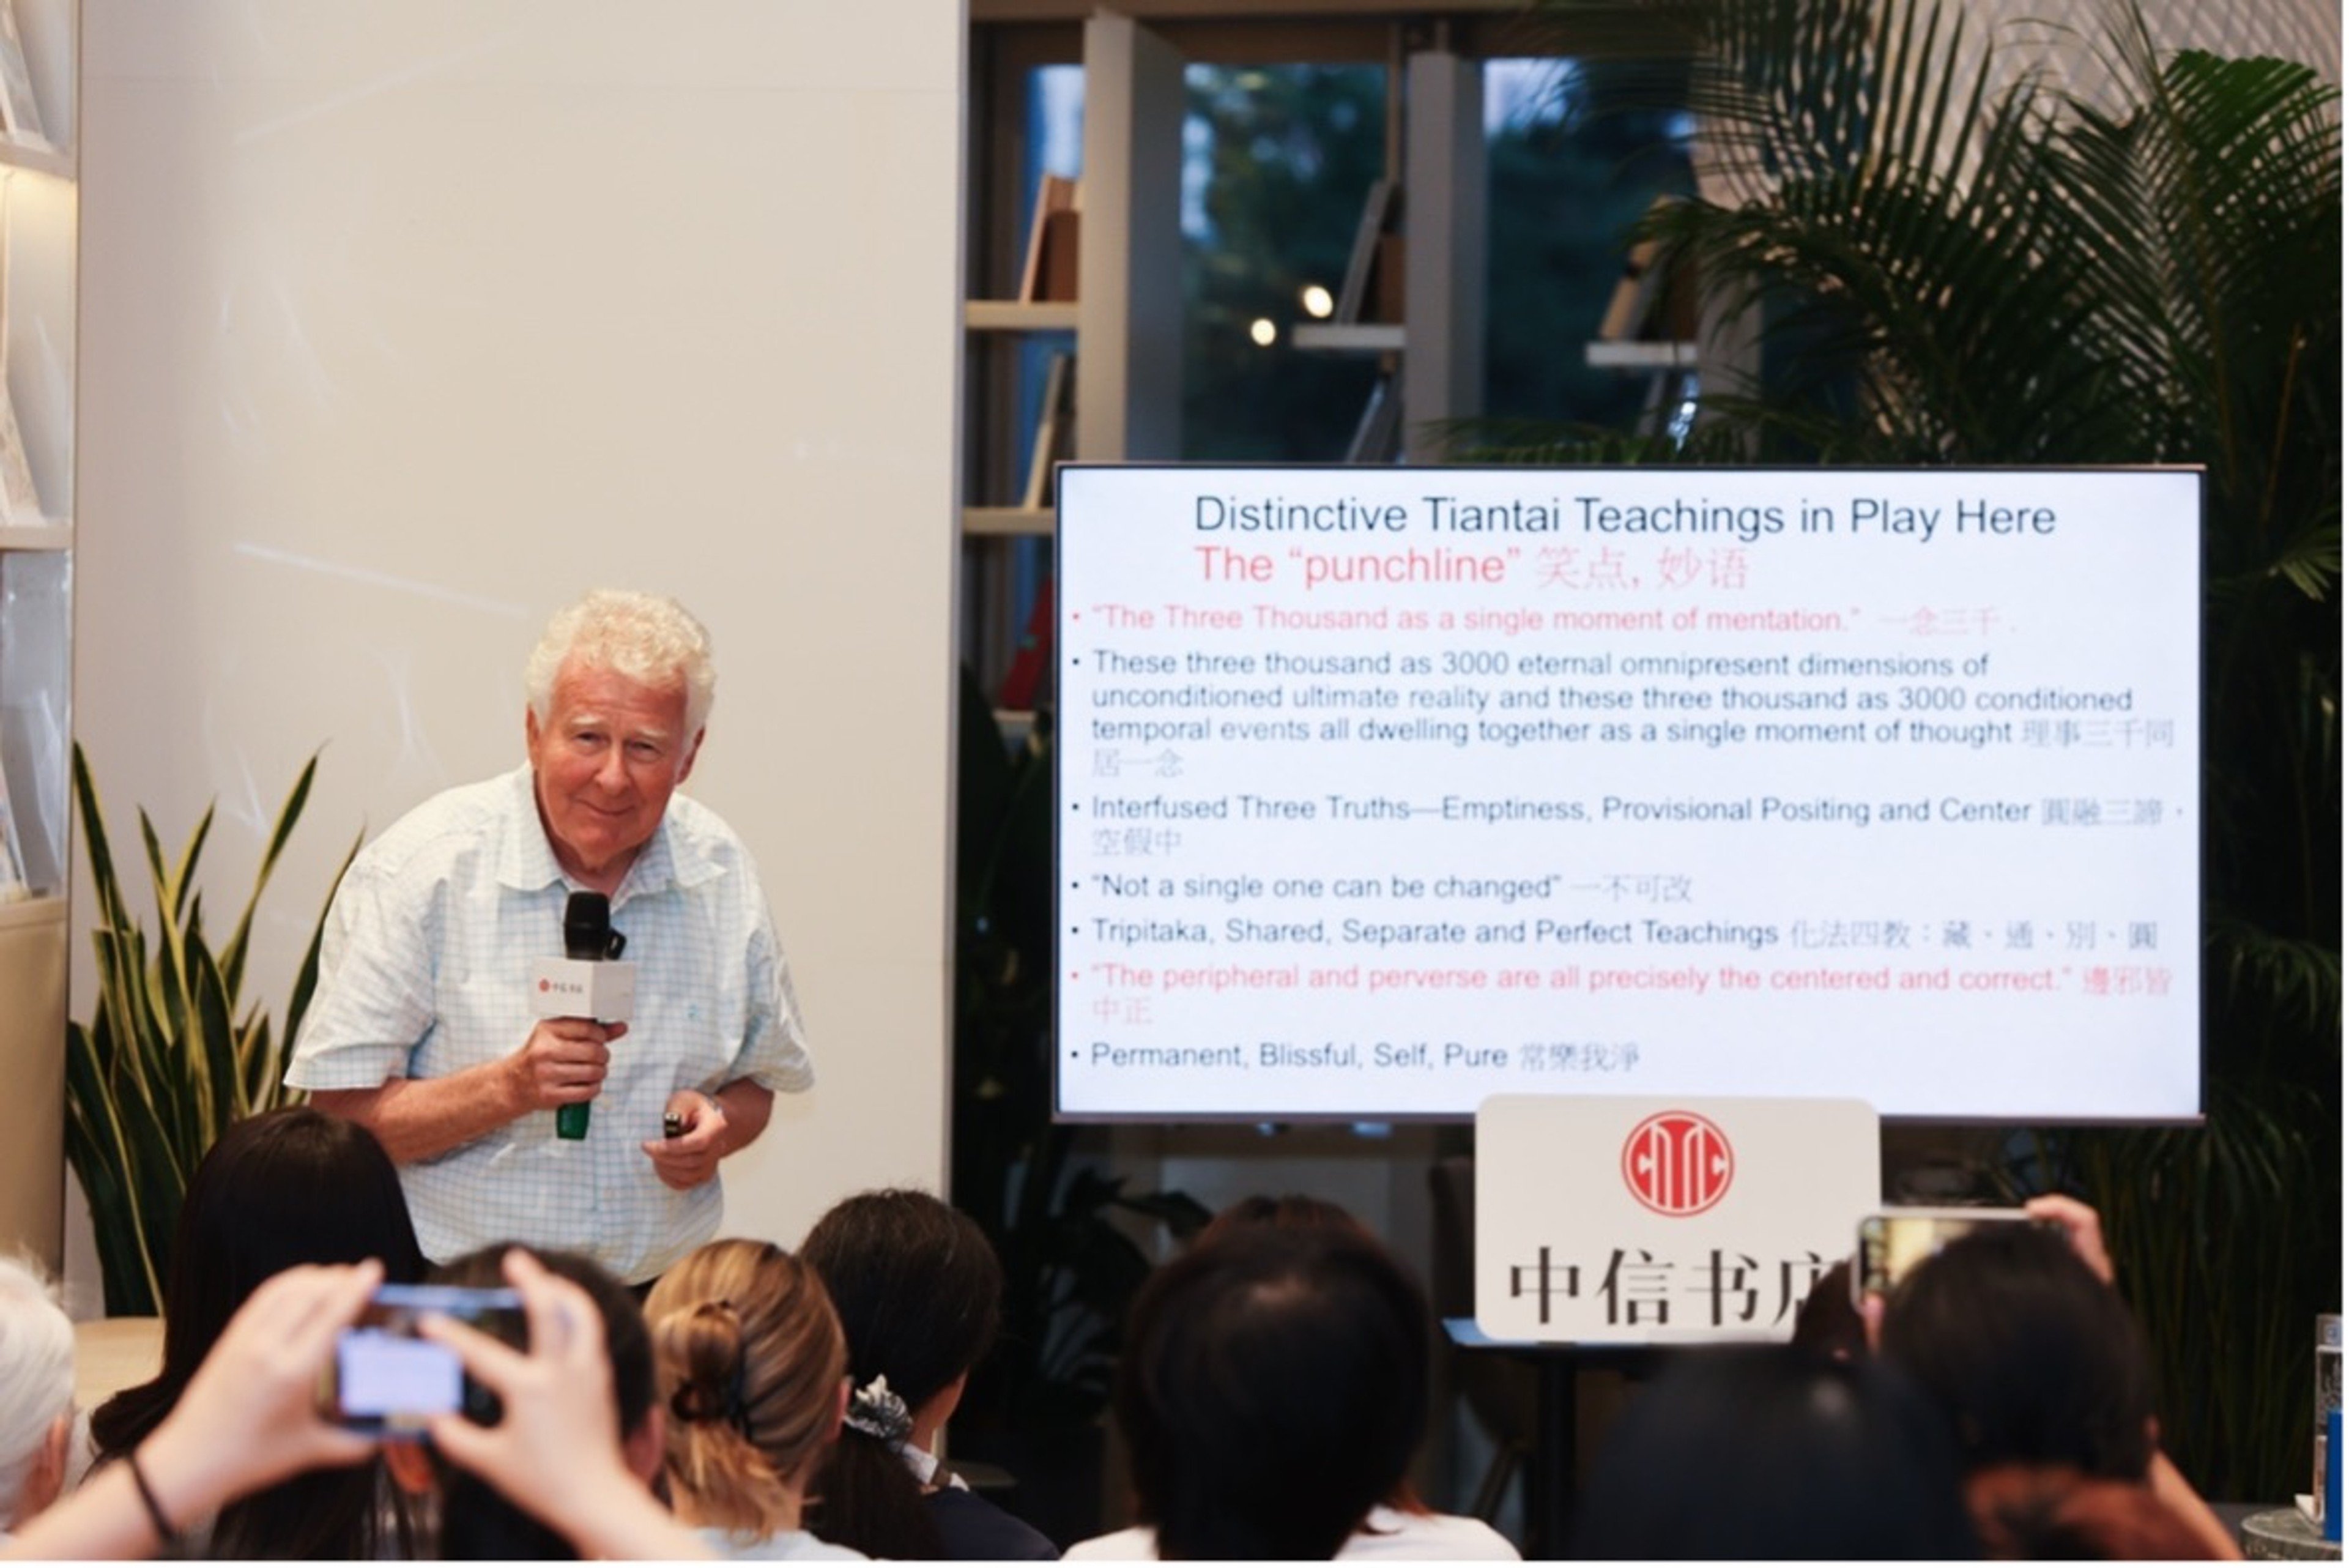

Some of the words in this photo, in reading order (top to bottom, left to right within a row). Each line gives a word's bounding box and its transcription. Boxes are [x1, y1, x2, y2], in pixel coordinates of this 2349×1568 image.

[1195, 494, 1408, 535] Distinctive
[1420, 495, 1560, 534] Tiantai
[1573, 496, 1786, 543] Teachings
[1800, 497, 1835, 533] in
[1850, 497, 1942, 544] Play
[1956, 498, 2057, 535] Here
[1194, 545, 1274, 582] The
[1657, 546, 1748, 590] 妙语
[1163, 603, 1243, 630] Three
[1252, 603, 1389, 630] Thousand
[1397, 610, 1430, 630] as
[1438, 611, 1455, 631] a
[1464, 602, 1544, 636] single
[1553, 608, 1663, 631] moment
[1671, 603, 1699, 632] of
[1093, 648, 1179, 675] These
[1186, 650, 1256, 675] three
[1264, 651, 1391, 675] thousand
[1399, 656, 1433, 675] as
[1442, 650, 1510, 676] 3000
[1517, 652, 1612, 676] eternal
[1620, 653, 1790, 680] omnipresent
[1797, 652, 1954, 677] dimensions
[1962, 652, 1989, 678] of
[1092, 684, 1283, 708] unconditioned
[1293, 684, 1400, 709] ultimate
[1409, 685, 1490, 715] reality
[1499, 686, 1550, 710] and
[1558, 685, 1634, 710] these
[1642, 686, 1713, 710] three
[1721, 685, 1848, 711] thousand
[1856, 691, 1890, 711] as
[1898, 686, 1967, 712] 3000
[1975, 687, 2132, 712] conditioned
[1091, 716, 1212, 748] temporal
[1220, 719, 1310, 741] events
[1319, 717, 1349, 741] all
[1357, 717, 1469, 748] dwelling
[1477, 718, 1592, 748] together
[1599, 722, 1633, 743] as
[1640, 723, 1658, 743] a
[1666, 718, 1747, 749] single
[1755, 720, 1866, 743] moment
[1874, 718, 1902, 743] of
[1909, 719, 2013, 749] thought
[1092, 793, 1229, 820] Interfused
[1236, 793, 1317, 820] Three
[1601, 795, 1753, 822] Provisional
[1761, 795, 1871, 828] Positing
[1878, 797, 1931, 823] and
[1939, 797, 2032, 823] Center
[1157, 878, 1176, 899] a
[1183, 874, 1264, 905] single
[1272, 879, 1324, 899] one
[1332, 879, 1382, 899] can
[1390, 874, 1426, 899] be
[1570, 874, 1692, 902] 一不可改
[1341, 918, 1467, 950] Separate
[1474, 920, 1527, 945] and
[1535, 918, 1633, 945] Perfect
[1641, 918, 1780, 952] Teachings
[1162, 962, 1299, 994] peripheral
[1308, 964, 1360, 990] and
[1368, 965, 1488, 995] perverse
[1496, 969, 1542, 990] are
[1549, 965, 1580, 990] all
[1588, 964, 1711, 995] precisely
[1718, 965, 1762, 990] the
[1769, 966, 1891, 991] centered
[1898, 965, 1951, 991] and
[1093, 995, 1154, 1024] 中正
[1443, 1042, 1509, 1069] Pure
